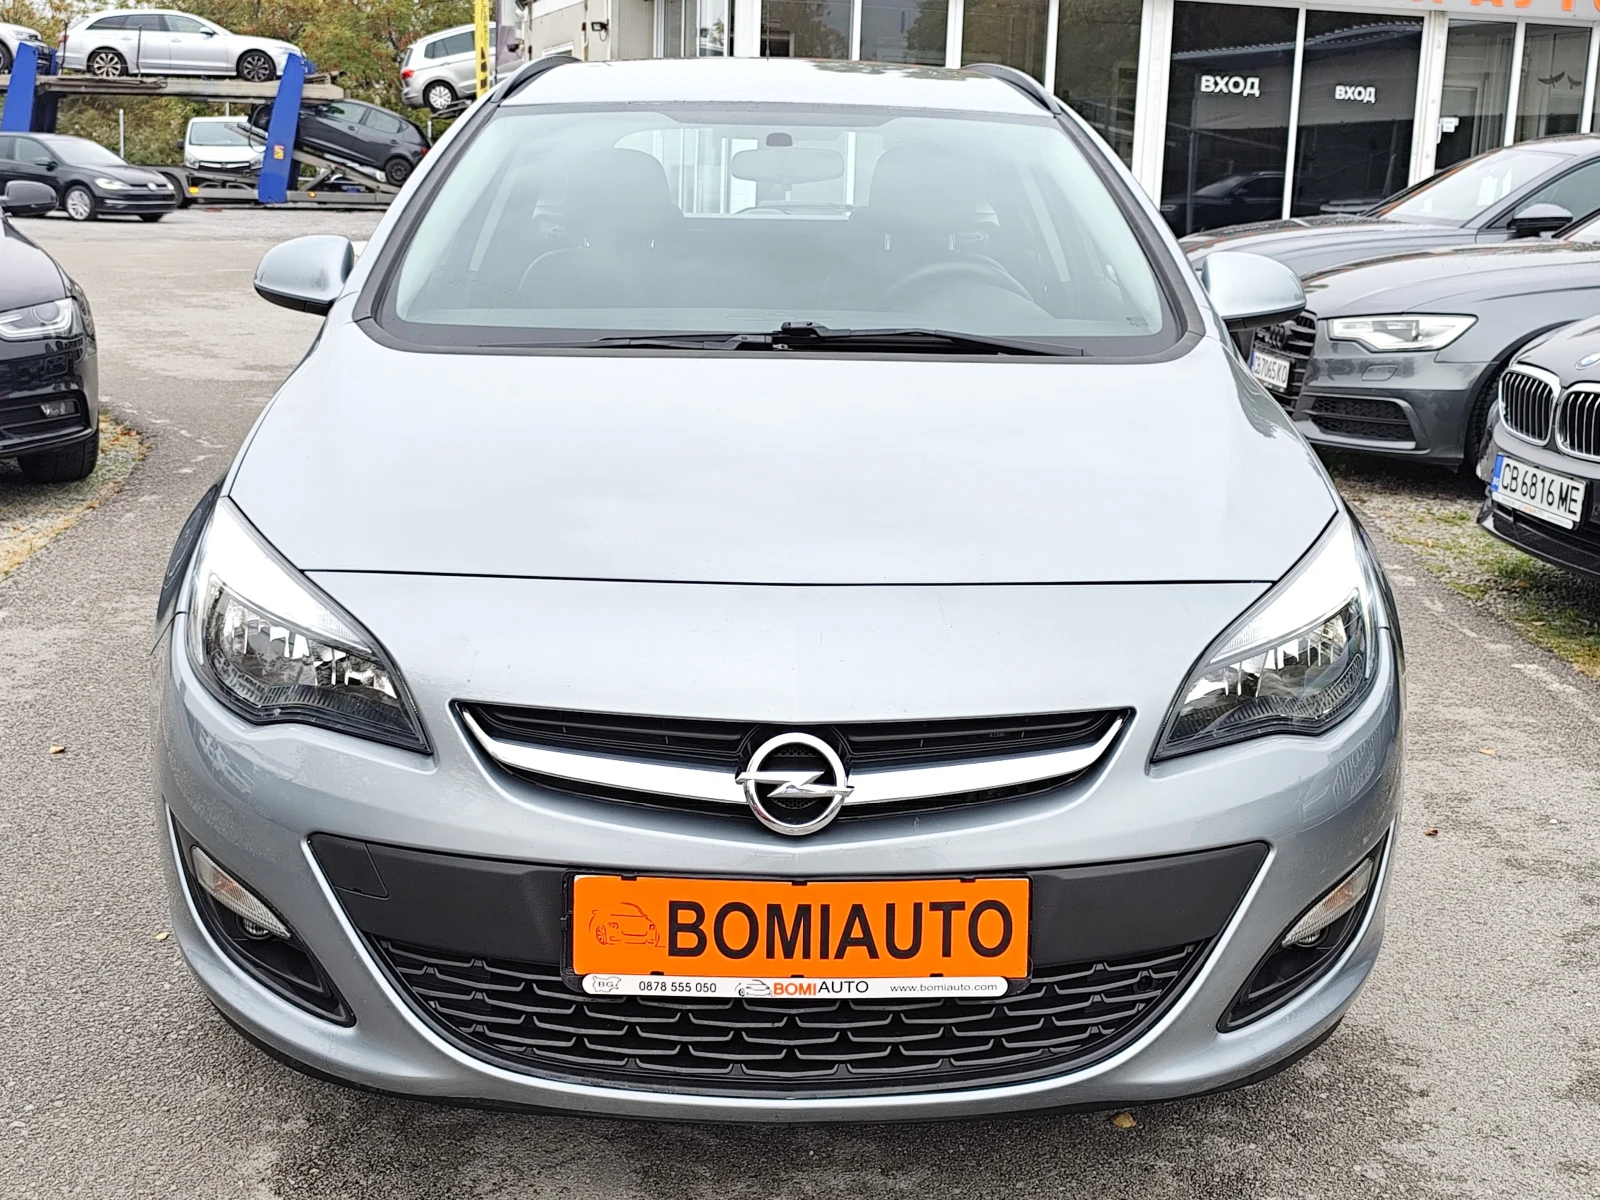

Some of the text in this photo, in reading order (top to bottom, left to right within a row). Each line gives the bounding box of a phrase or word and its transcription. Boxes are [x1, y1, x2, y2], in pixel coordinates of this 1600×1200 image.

[1200, 75, 1260, 97] ВХОД
[1335, 85, 1376, 103] ВХОД
[668, 900, 1013, 960] BOMIAUTO
[638, 981, 717, 993] 0878 555 050
[890, 983, 998, 992] www.bomiauto.com
